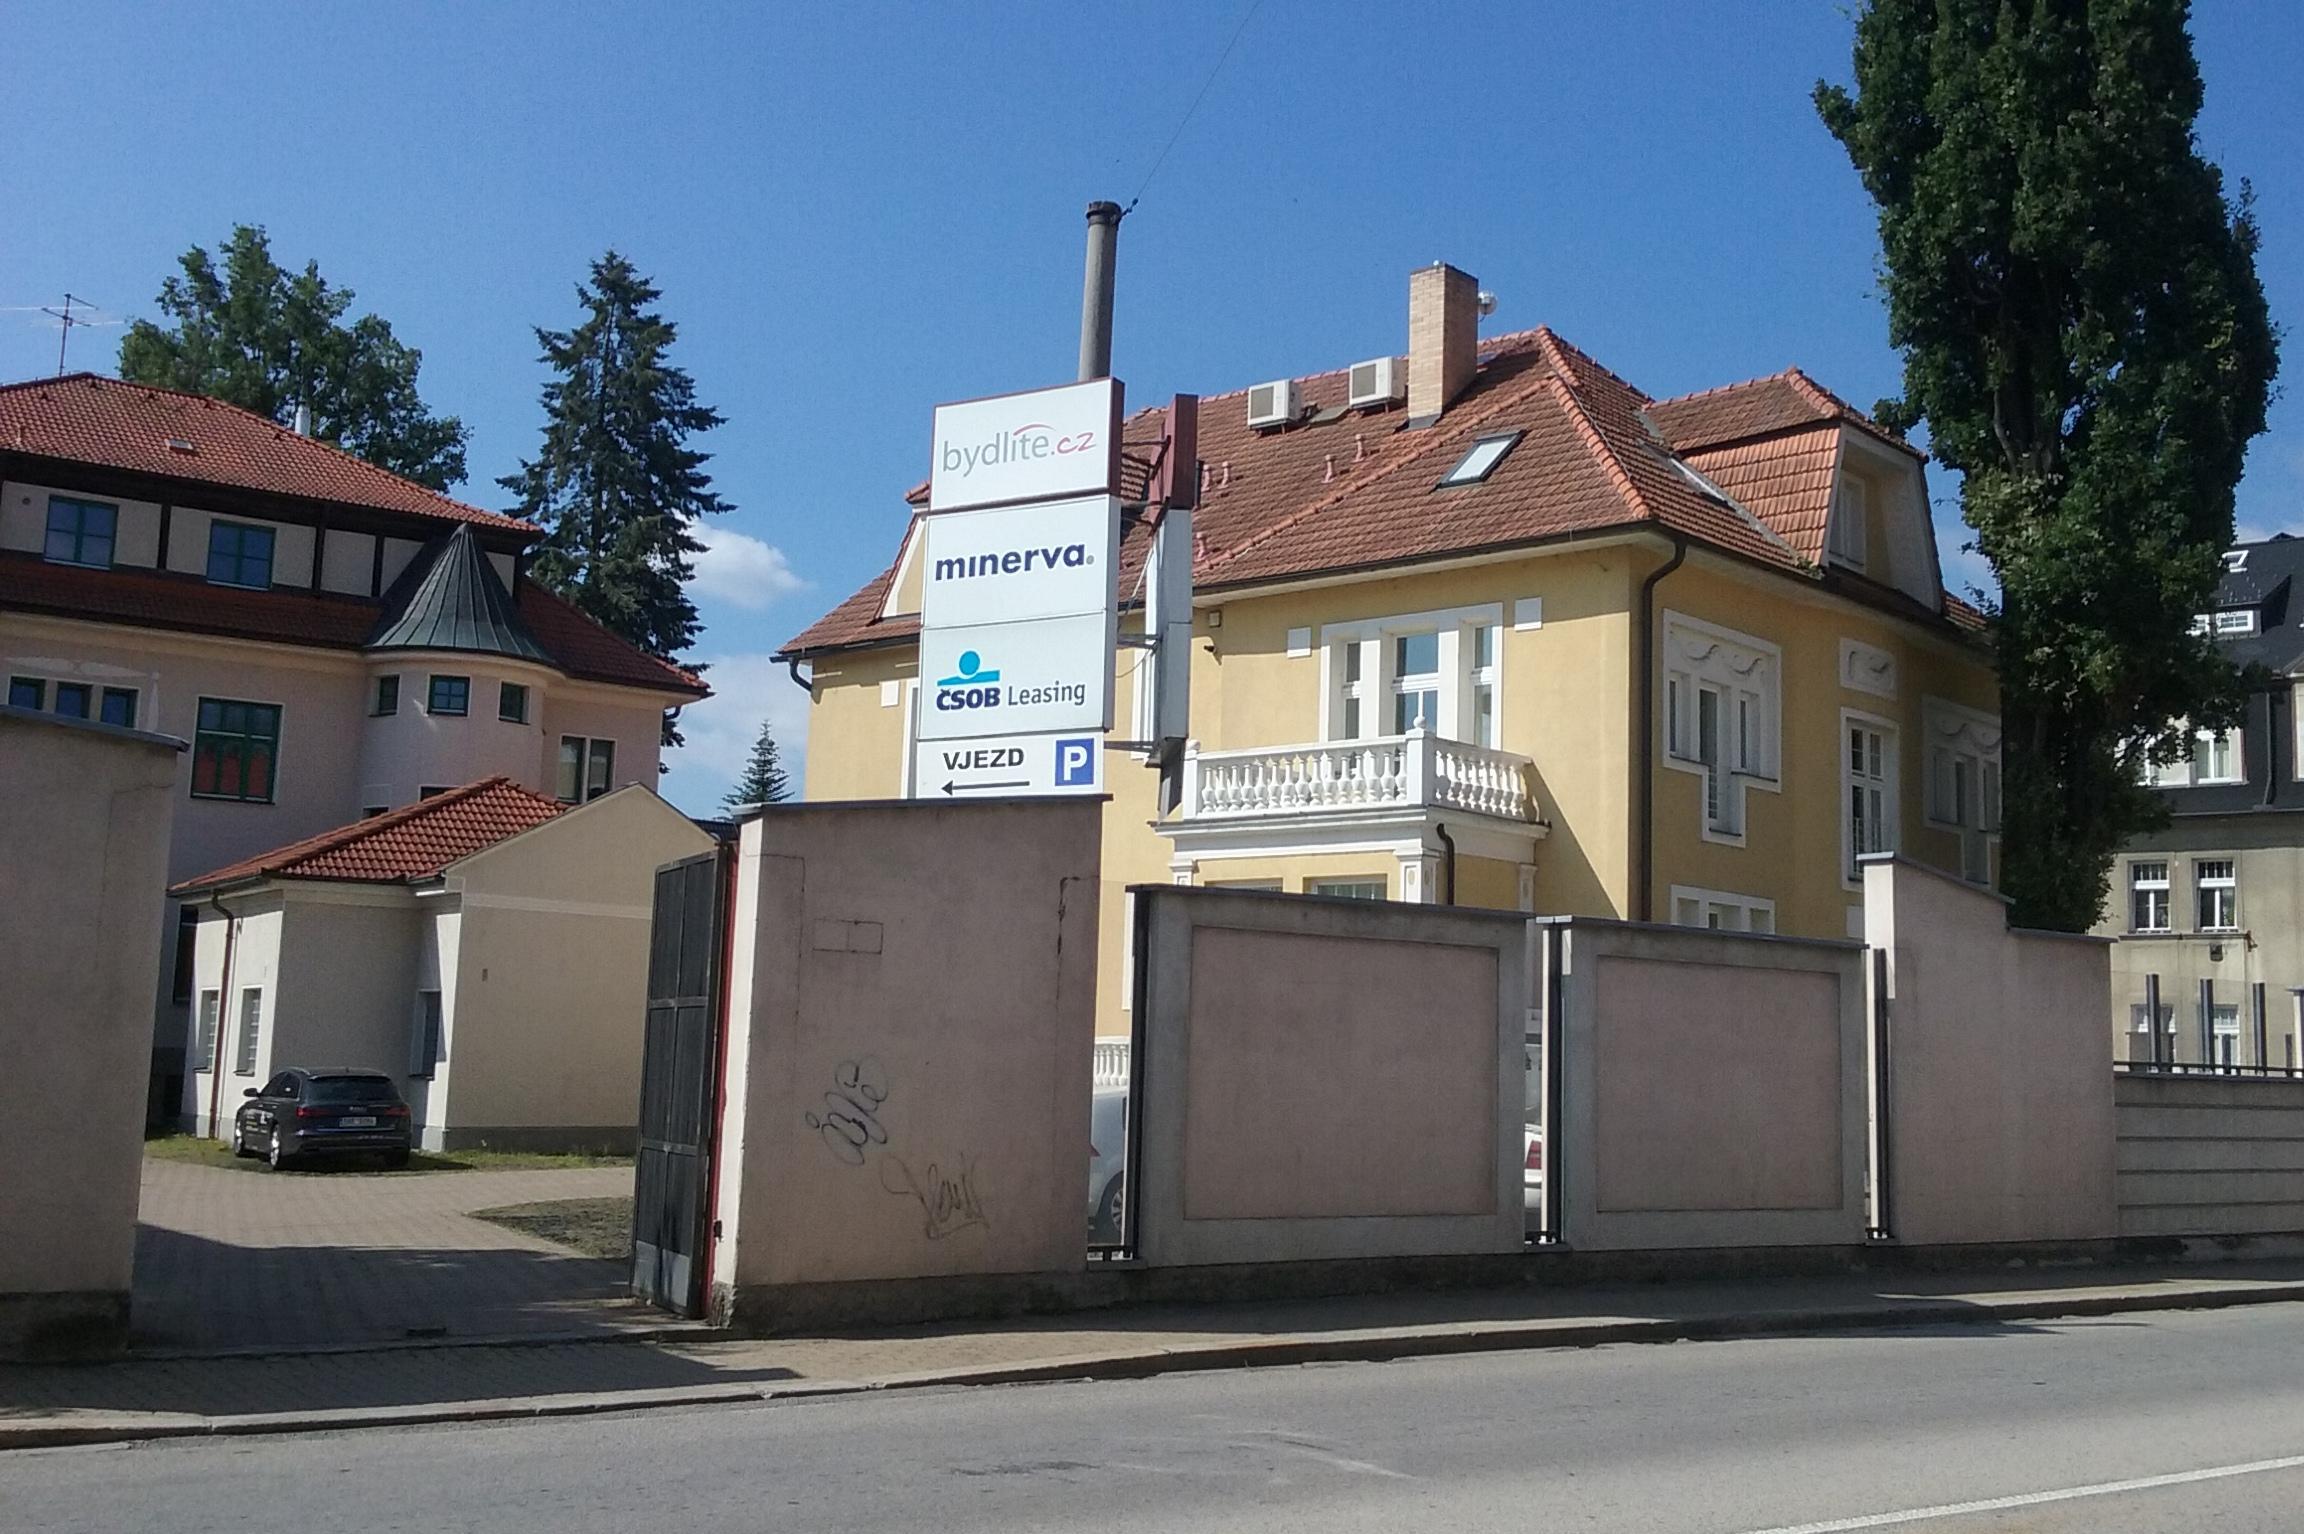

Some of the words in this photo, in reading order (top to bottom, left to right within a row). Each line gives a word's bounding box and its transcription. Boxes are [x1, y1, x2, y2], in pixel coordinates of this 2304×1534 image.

[943, 424, 1097, 477] bydlite.cz
[936, 688, 1000, 711] ČSOB
[1008, 681, 1086, 706] Leasing
[943, 748, 1024, 770] VJEZD
[1063, 745, 1087, 781] P
